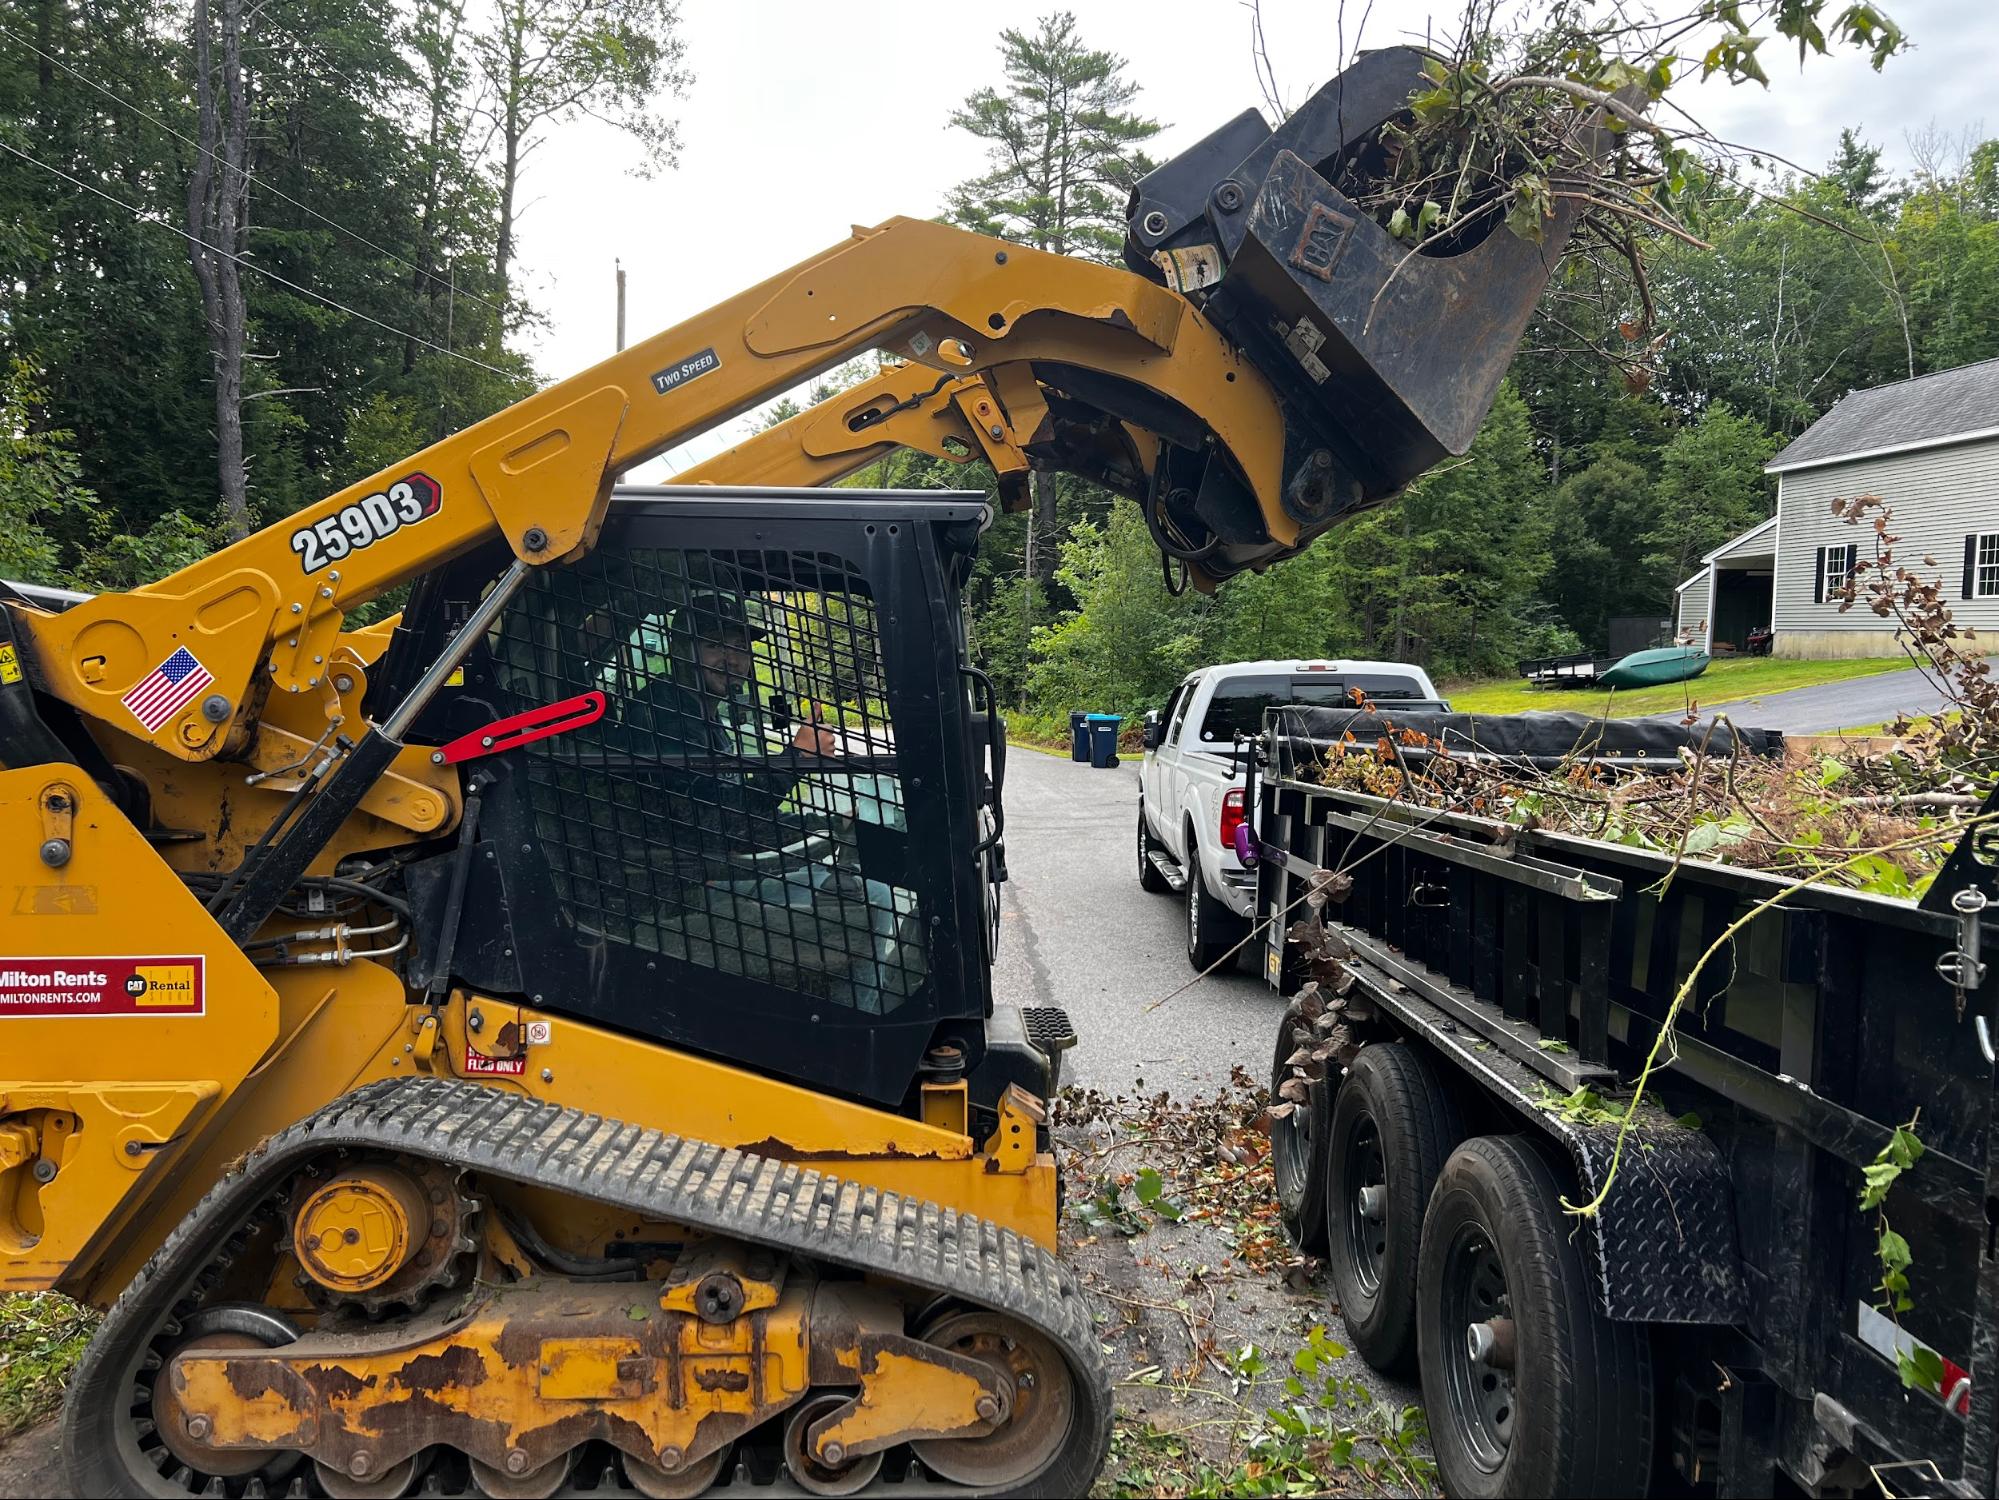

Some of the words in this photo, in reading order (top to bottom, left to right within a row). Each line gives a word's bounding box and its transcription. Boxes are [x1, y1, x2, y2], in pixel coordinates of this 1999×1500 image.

[292, 481, 423, 574] 259D3
[53, 970, 107, 987] Rents
[127, 980, 144, 992] CAT
[149, 980, 191, 991] Rental
[496, 1060, 523, 1073] ONLY
